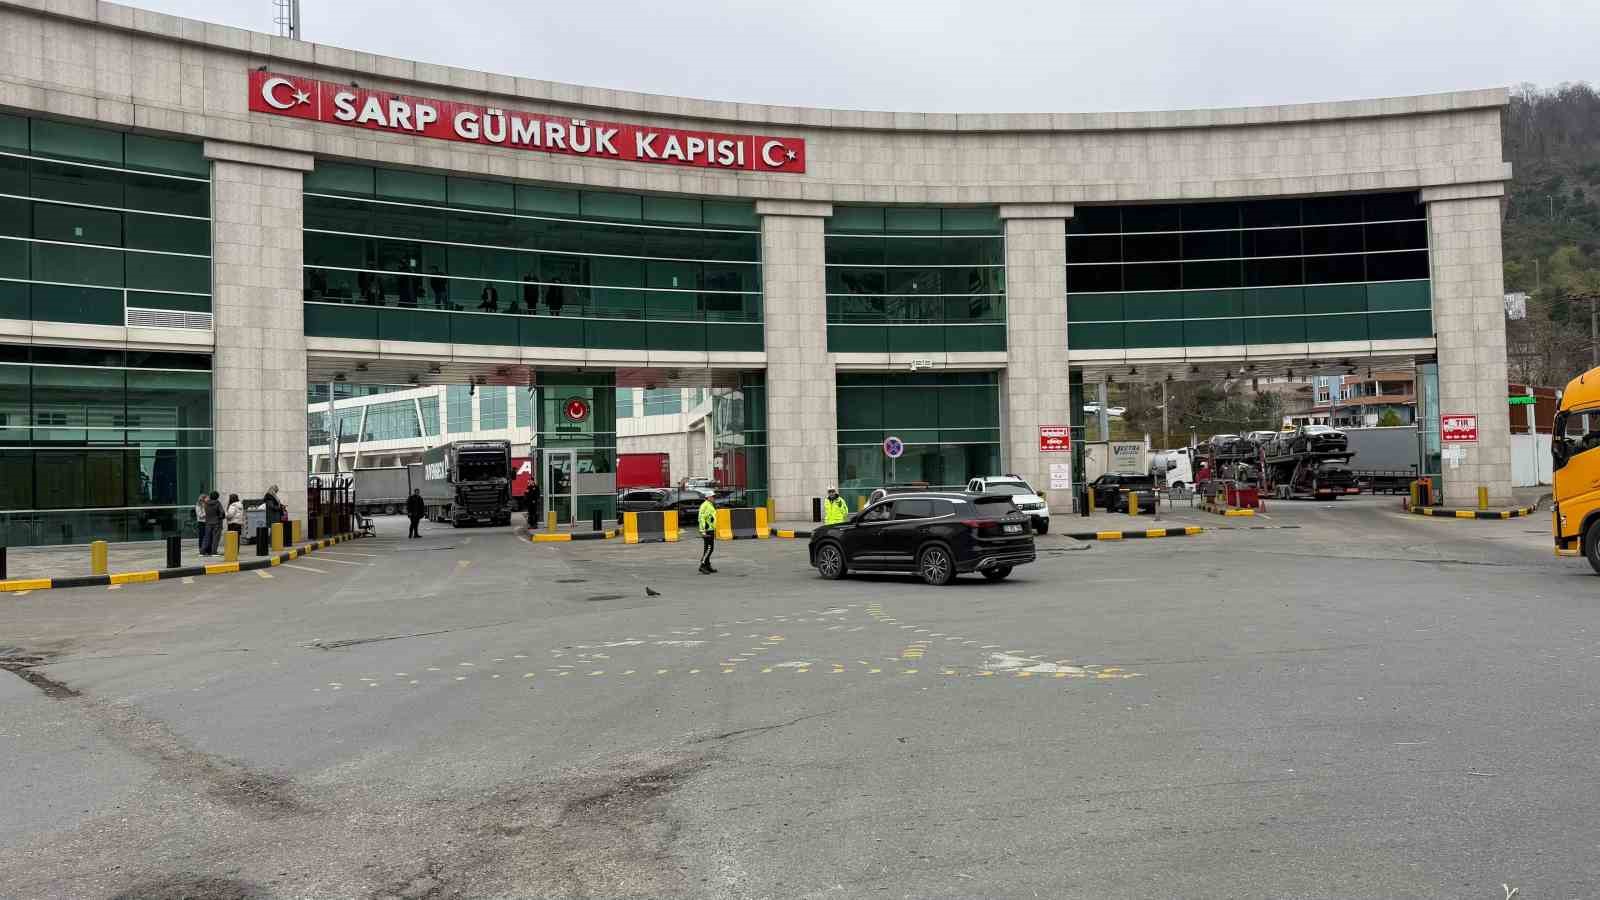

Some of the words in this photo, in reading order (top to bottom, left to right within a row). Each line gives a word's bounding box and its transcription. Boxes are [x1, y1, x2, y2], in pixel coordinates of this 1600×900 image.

[334, 88, 438, 131] SARP
[454, 107, 619, 154] GÜMRÜK
[635, 131, 745, 166] KAPISI
